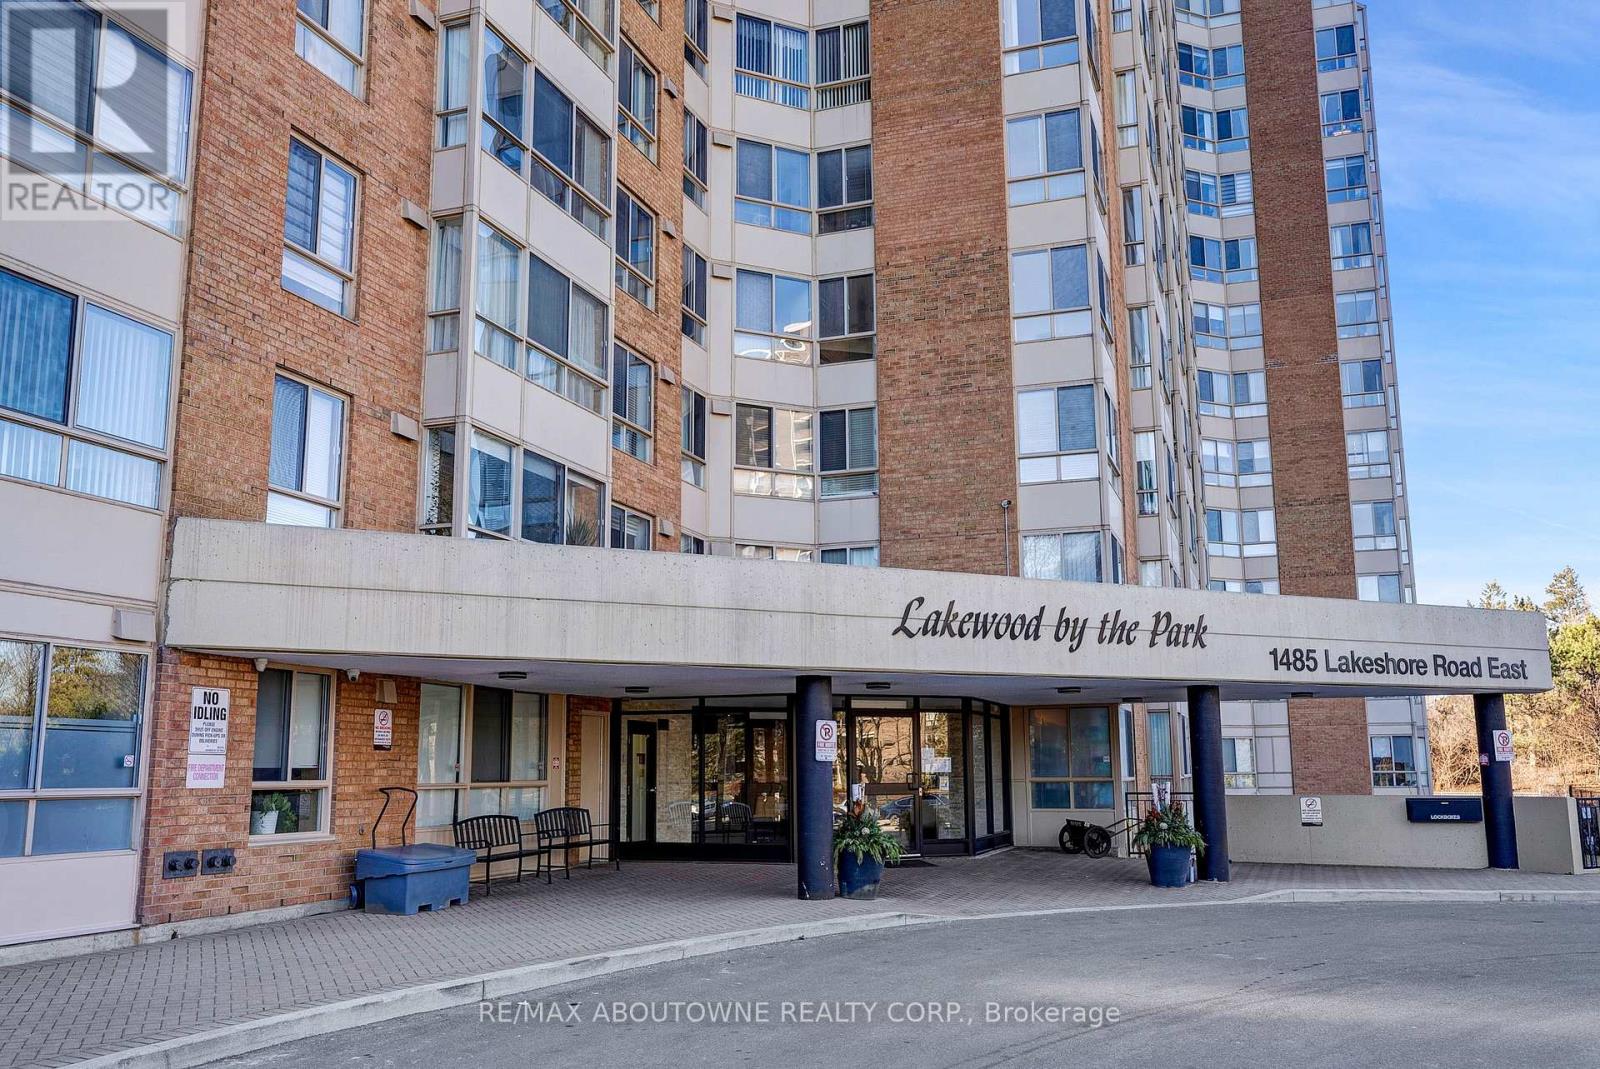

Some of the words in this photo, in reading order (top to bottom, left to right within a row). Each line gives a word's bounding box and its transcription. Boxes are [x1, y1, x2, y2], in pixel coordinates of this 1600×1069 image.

[892, 596, 1046, 641] Lakewood
[1053, 606, 1089, 653] by
[1097, 608, 1140, 645] the
[1149, 610, 1208, 649] Park
[1269, 648, 1318, 672] 1485
[1325, 650, 1428, 676] Lakeshore
[1433, 654, 1483, 678] Road
[1488, 657, 1528, 680] East
[203, 692, 219, 705] NO
[194, 706, 227, 720] IDLING
